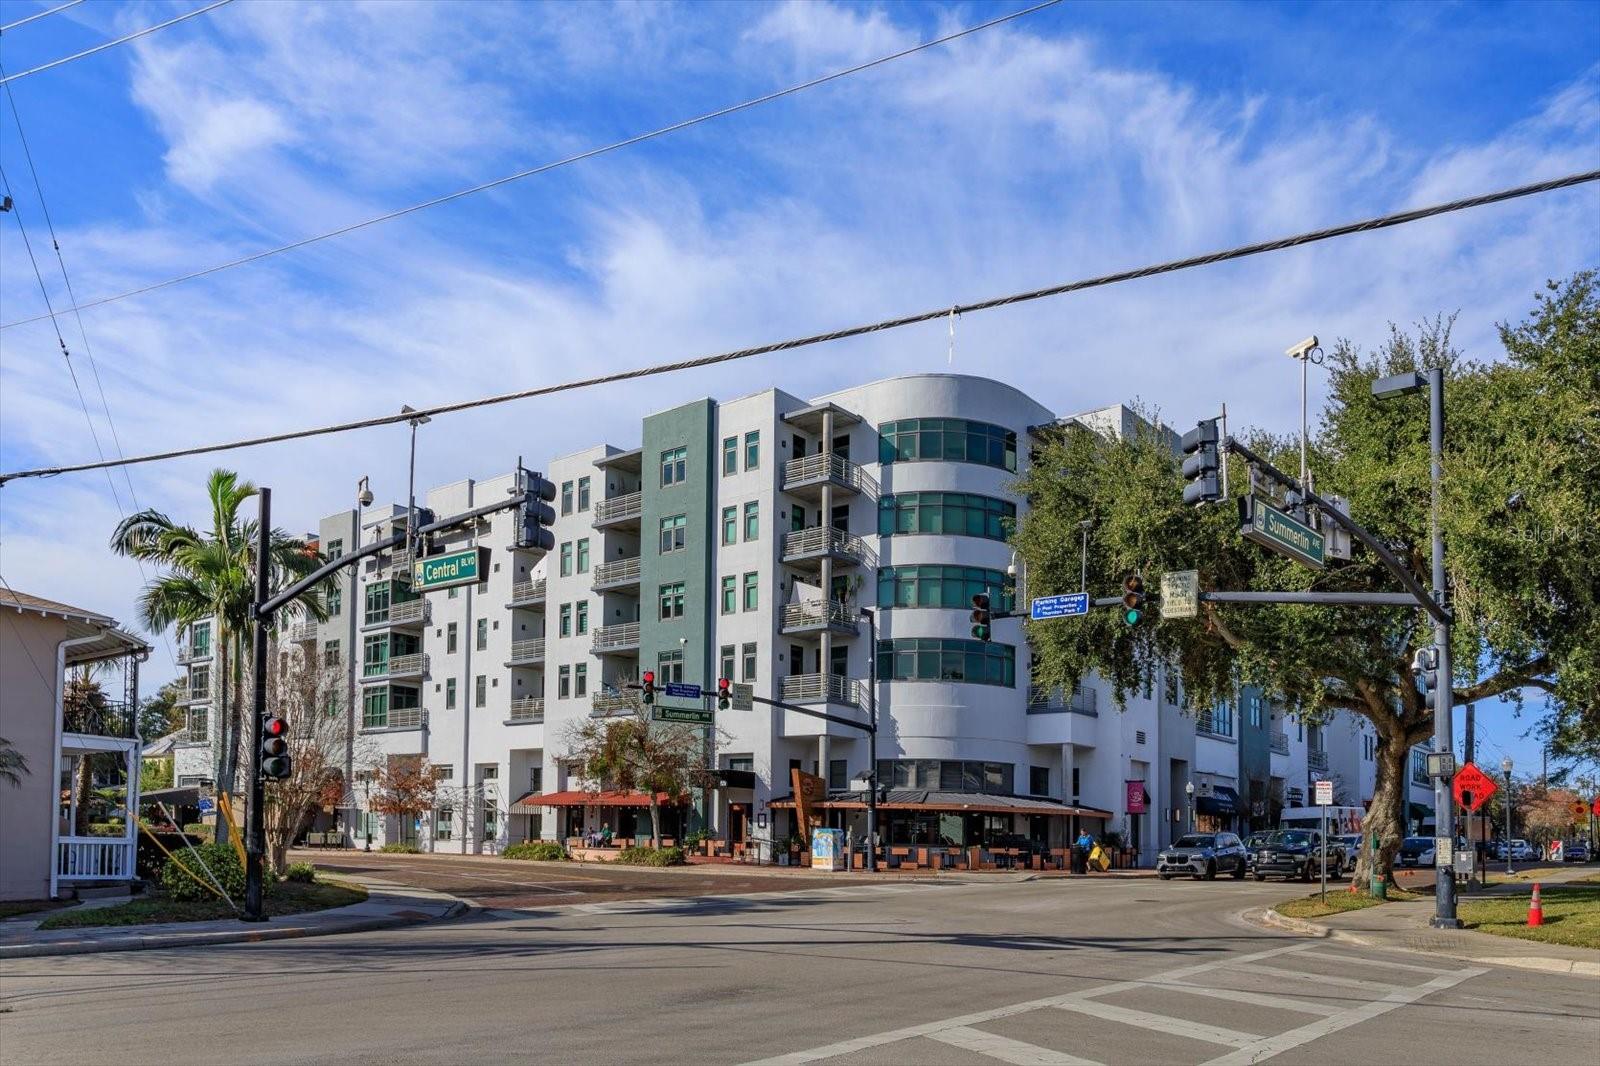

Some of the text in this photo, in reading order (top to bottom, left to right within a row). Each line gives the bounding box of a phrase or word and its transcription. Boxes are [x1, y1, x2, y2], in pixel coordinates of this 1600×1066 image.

[1269, 513, 1309, 550] Summerlin
[426, 556, 475, 580] Central BLVD
[1060, 595, 1085, 603] Garages
[665, 710, 700, 720] Summerlin
